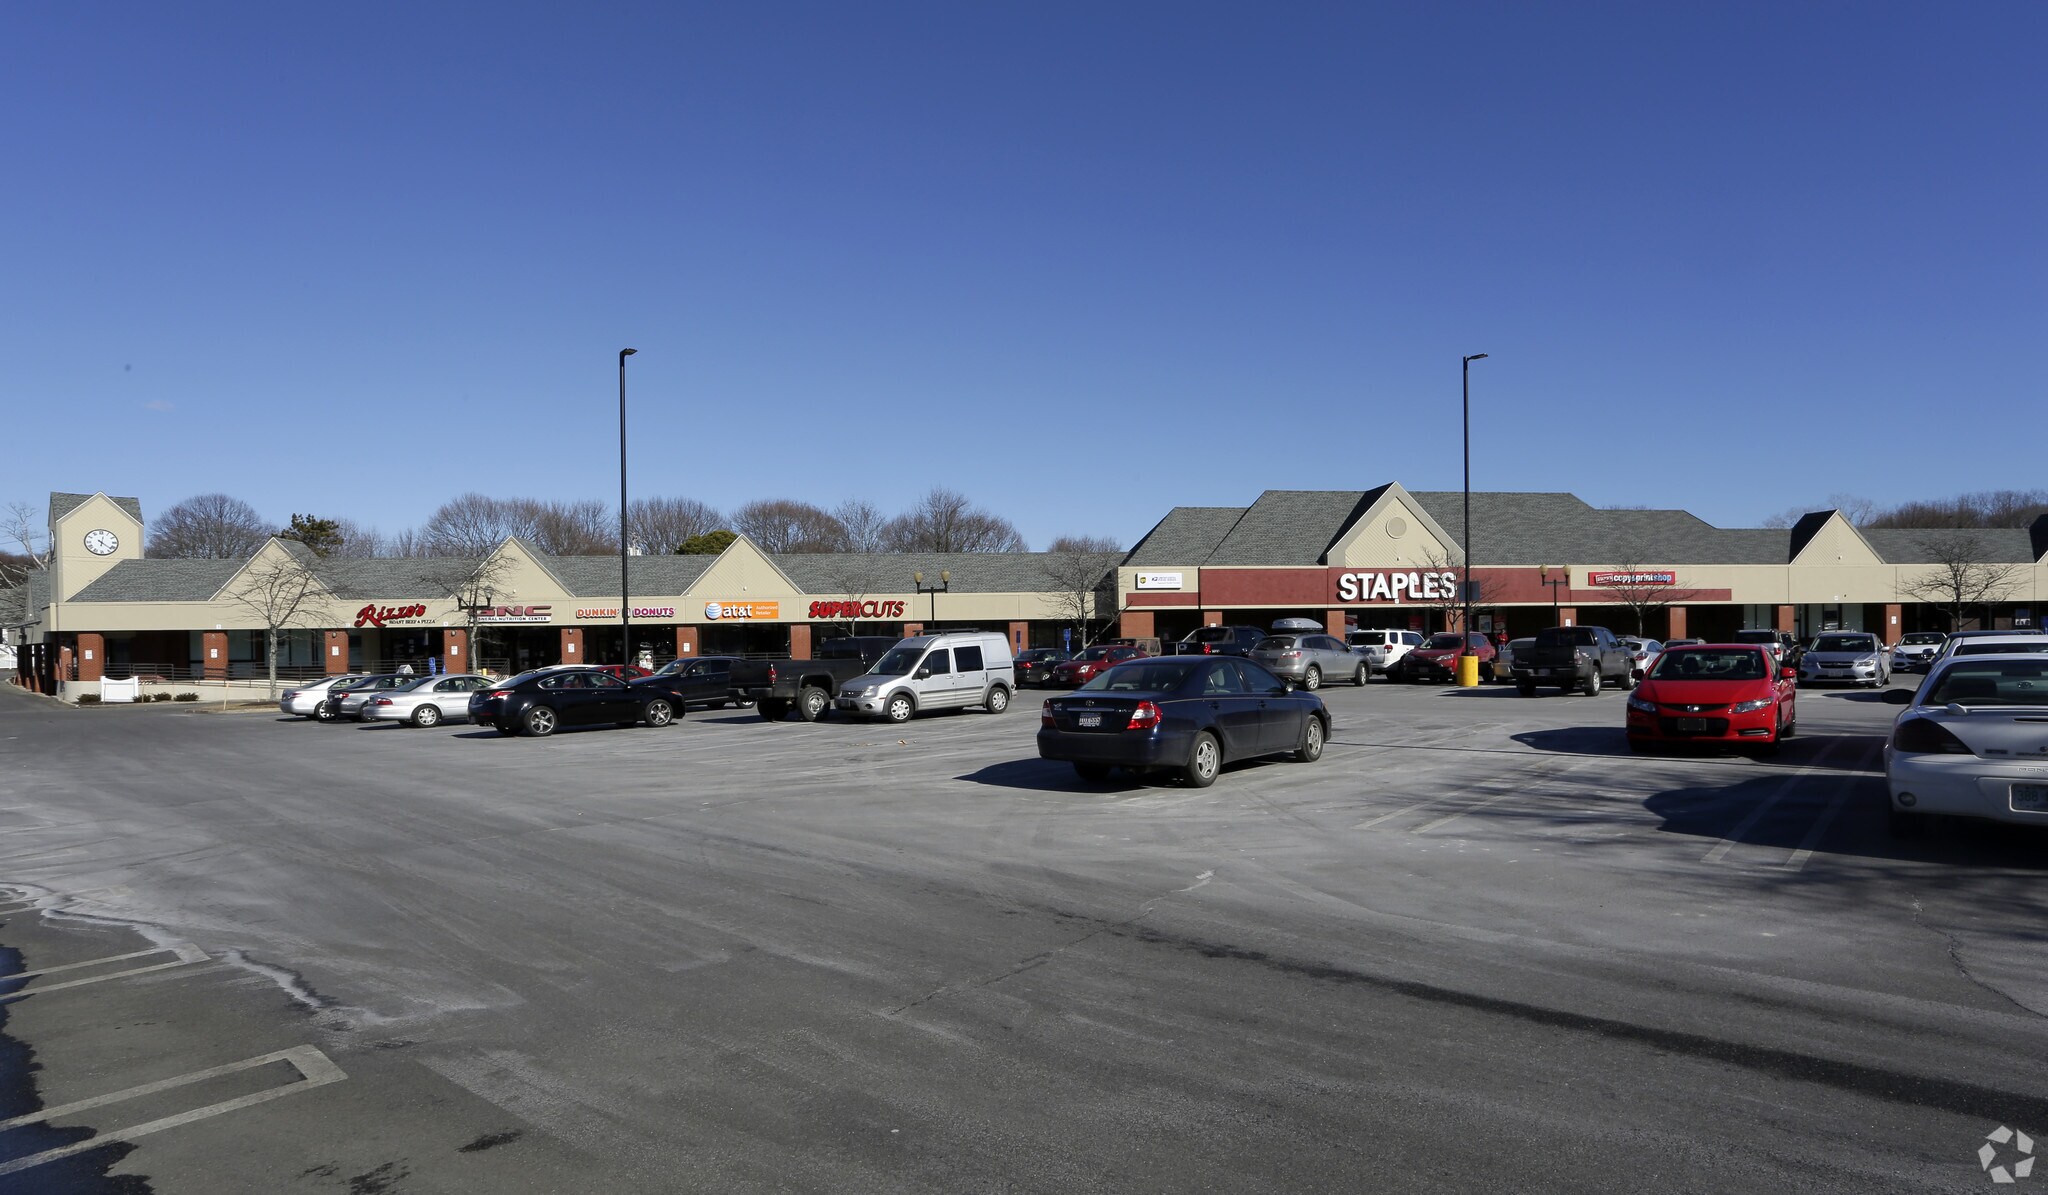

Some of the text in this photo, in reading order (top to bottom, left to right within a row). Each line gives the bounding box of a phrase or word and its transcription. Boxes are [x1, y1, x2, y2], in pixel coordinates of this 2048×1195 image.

[1339, 571, 1457, 600] STAPLES
[354, 604, 427, 628] Rizzo's
[576, 607, 676, 617] DUNKIN' DONUTS
[723, 604, 753, 618] at&t
[809, 601, 905, 618] SUPERCUTS
